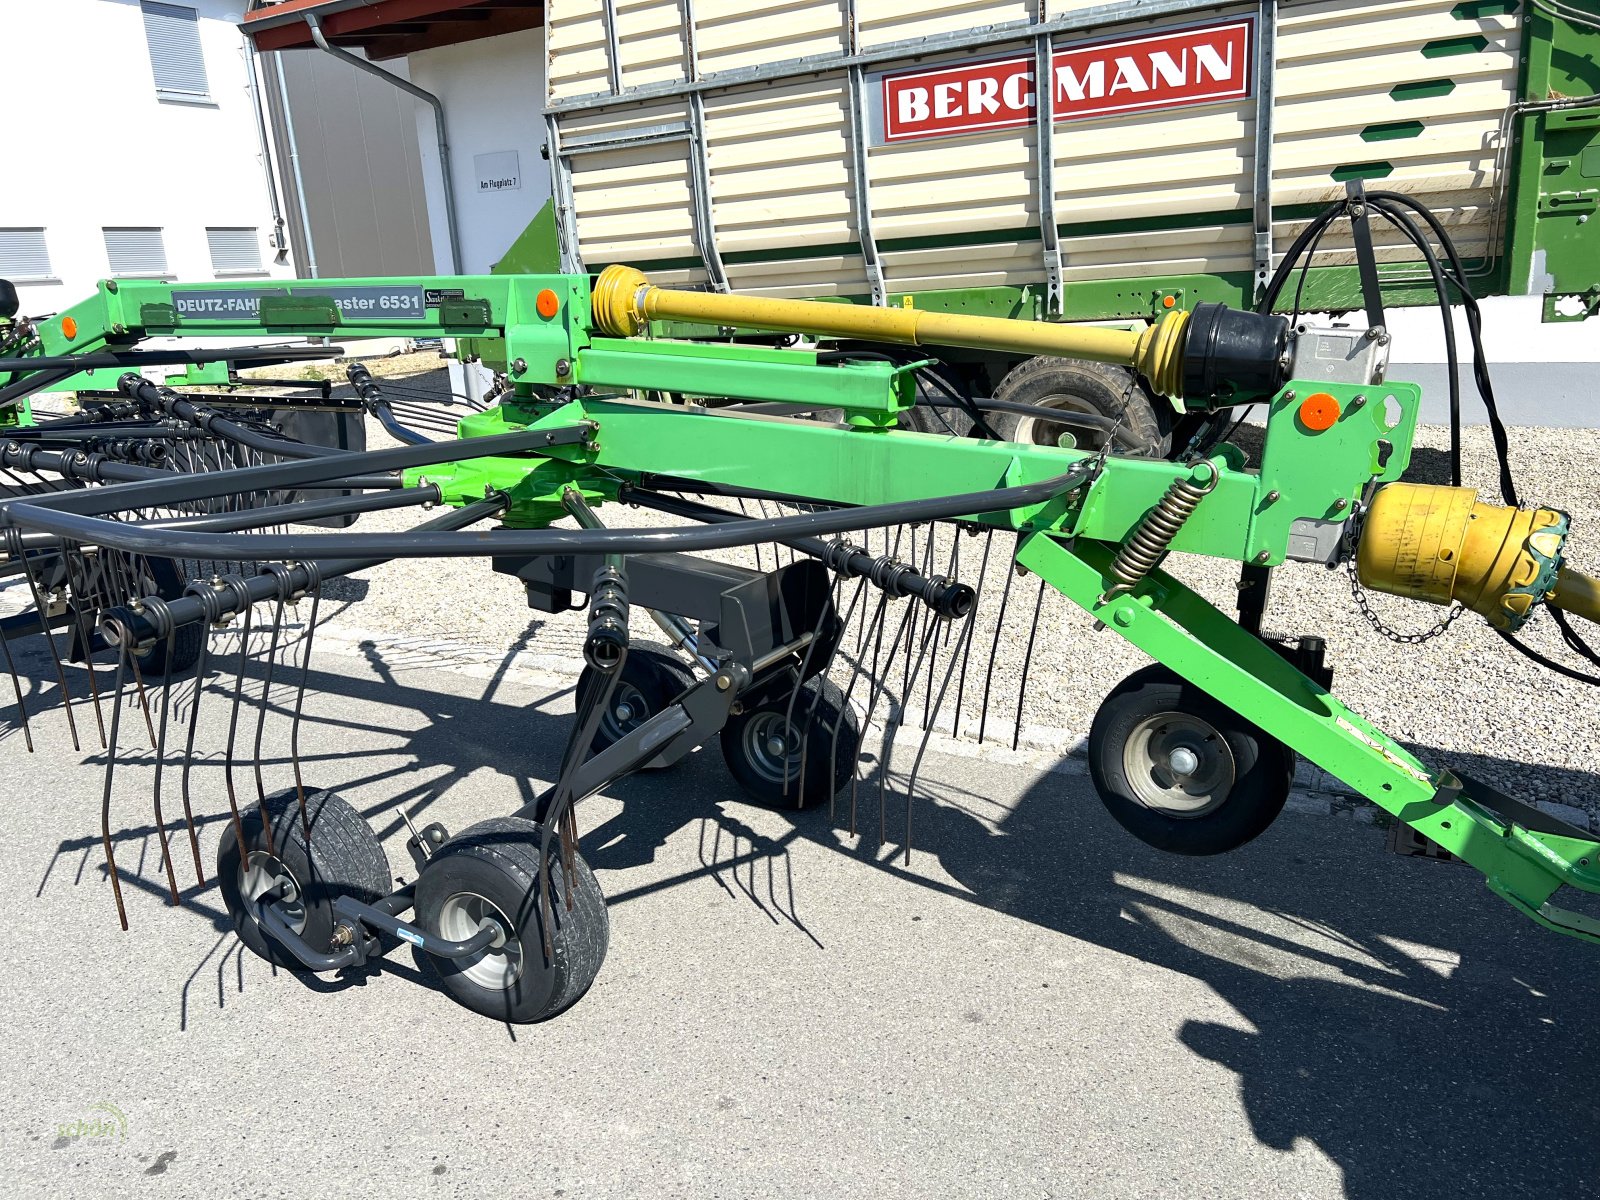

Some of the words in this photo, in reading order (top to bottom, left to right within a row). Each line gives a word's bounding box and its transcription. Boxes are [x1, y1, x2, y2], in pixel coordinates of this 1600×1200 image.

[897, 40, 1233, 124] BERGMANN
[480, 181, 489, 189] Am
[489, 178, 512, 189] Flugplatz
[512, 177, 516, 185] 7
[176, 297, 260, 312] DEUTZ-FAH
[334, 297, 375, 310] aster
[379, 295, 420, 310] 6531
